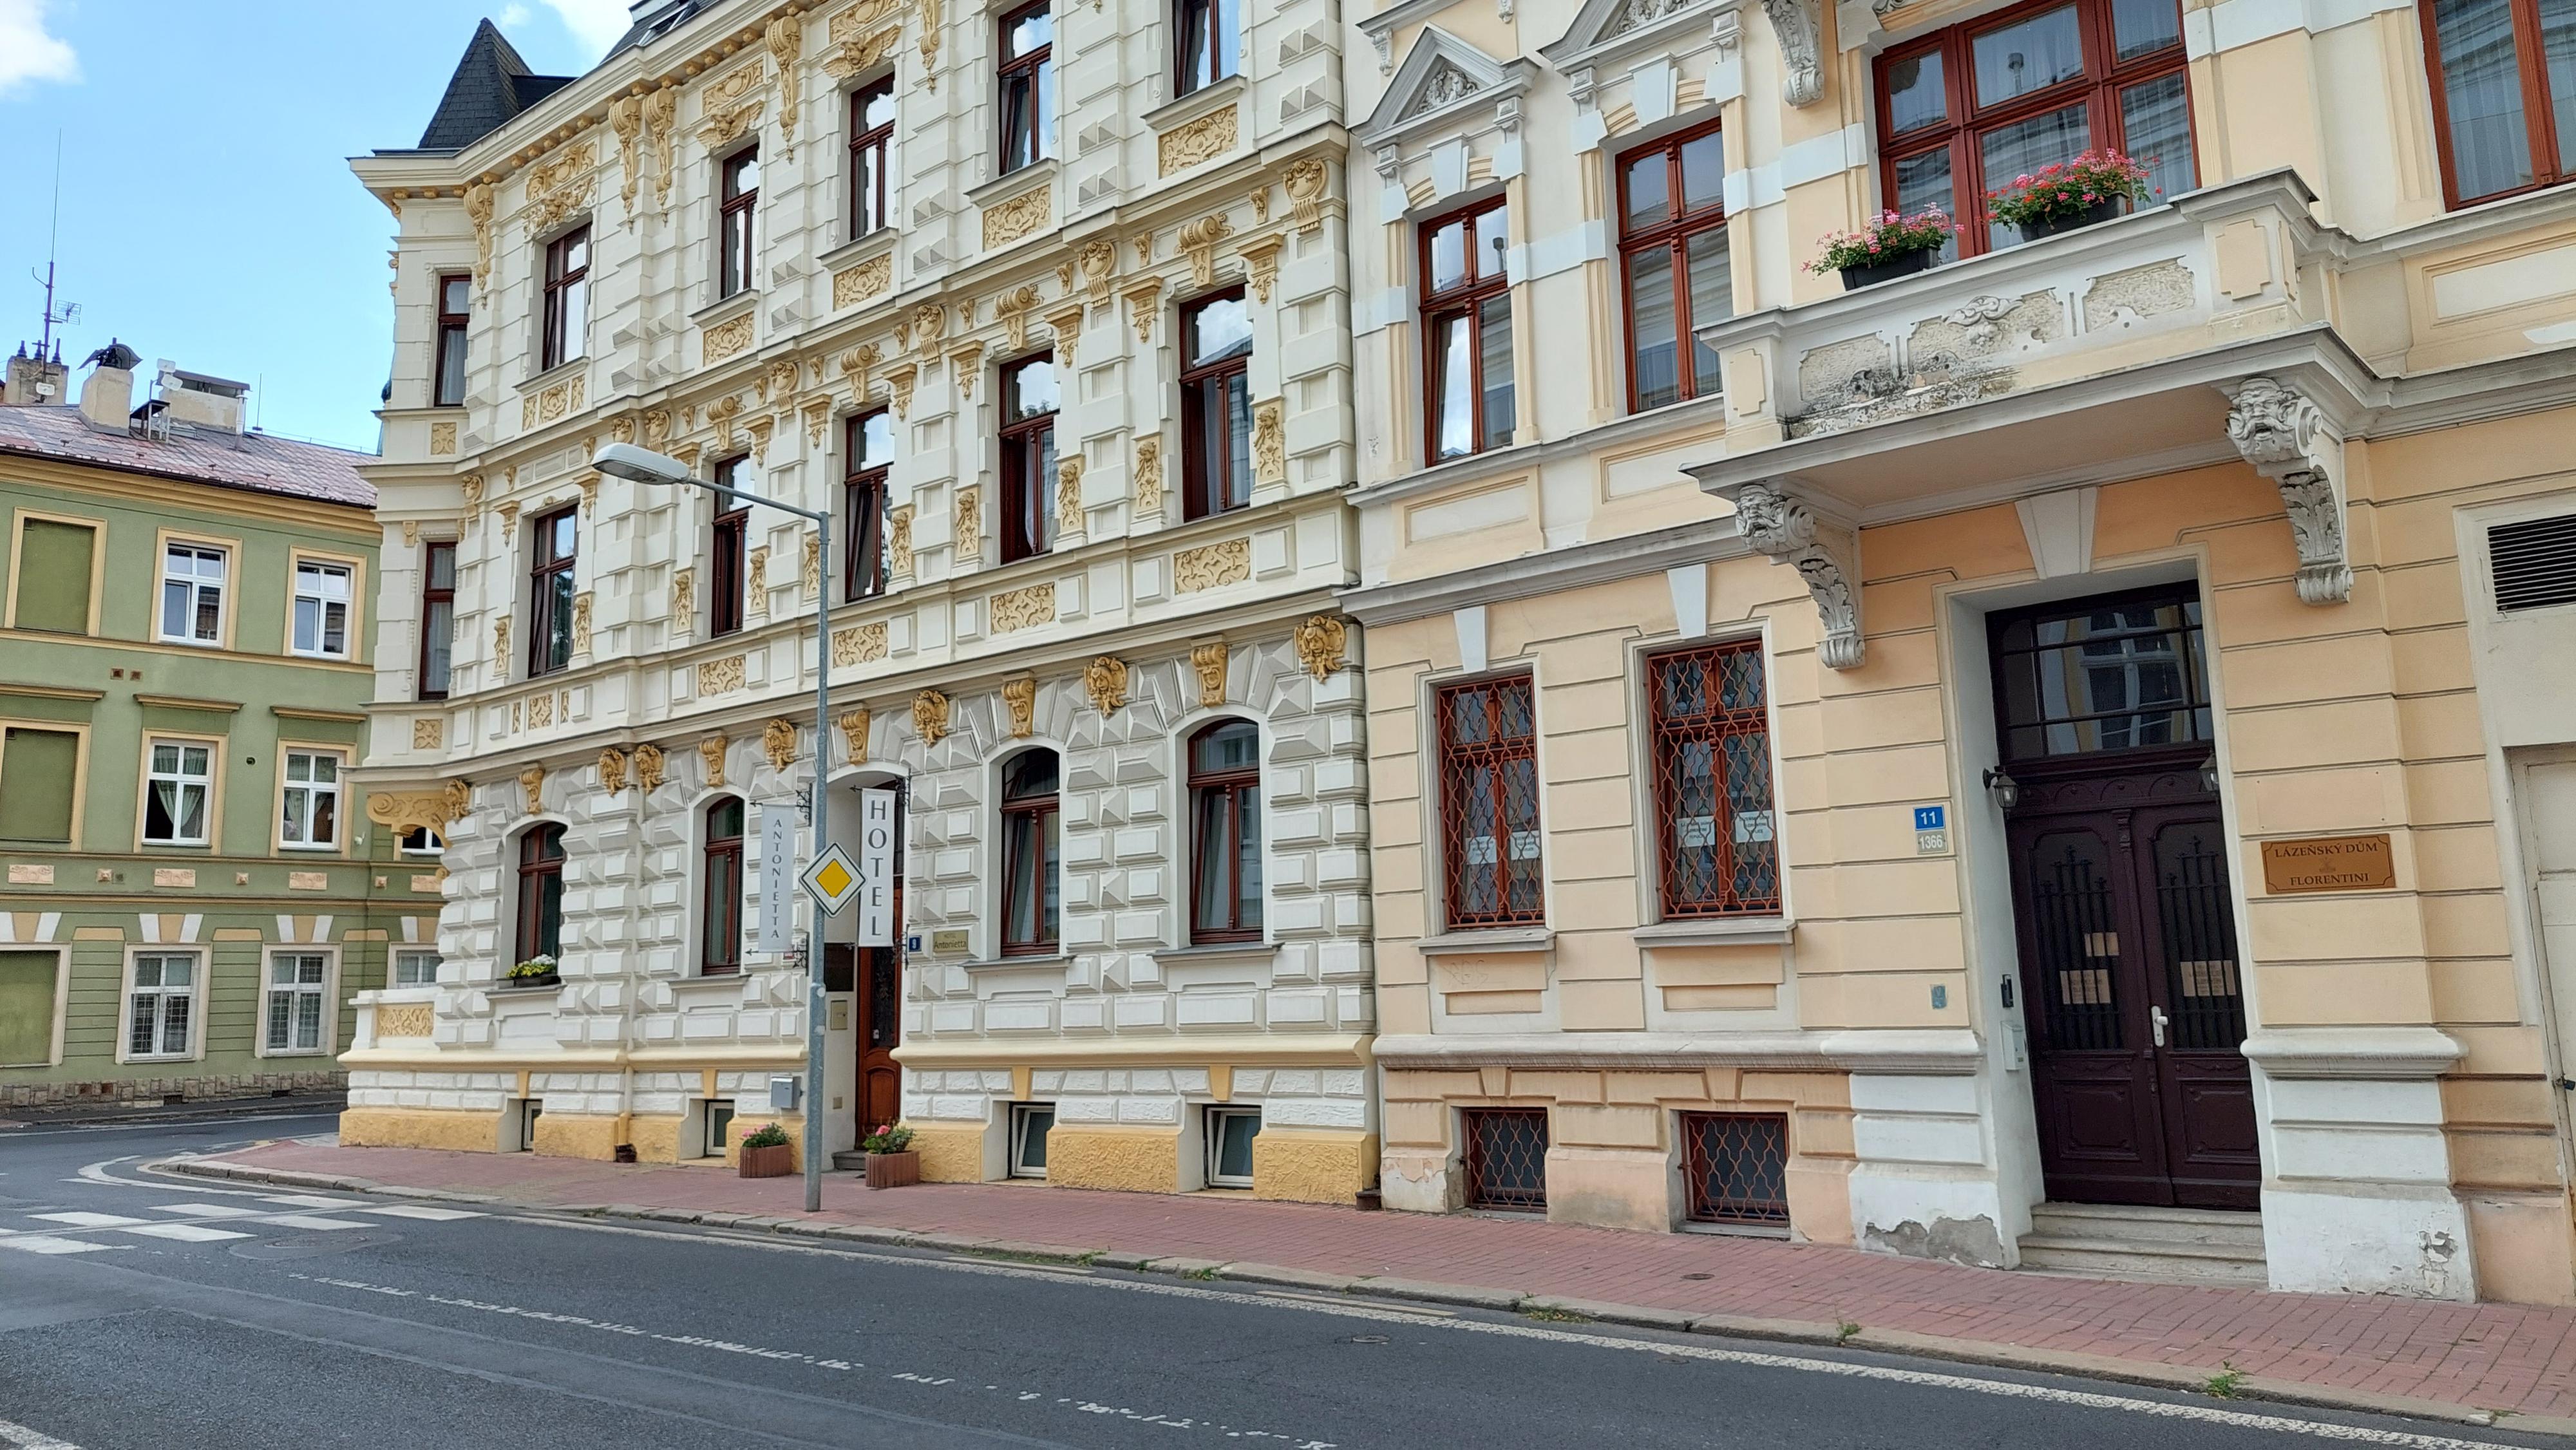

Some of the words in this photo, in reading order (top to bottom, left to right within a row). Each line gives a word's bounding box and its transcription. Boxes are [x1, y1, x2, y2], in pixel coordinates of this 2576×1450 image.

[1920, 811, 1936, 825] 11
[1919, 834, 1943, 849] 1366
[2274, 844, 2342, 858] LÁZEŇSKÝ
[2345, 842, 2378, 853] DŮM
[867, 800, 887, 936] HOTEL
[771, 818, 783, 938] ANTONIETTA
[2290, 872, 2370, 886] FLORENTINI
[934, 940, 967, 949] Antonietta
